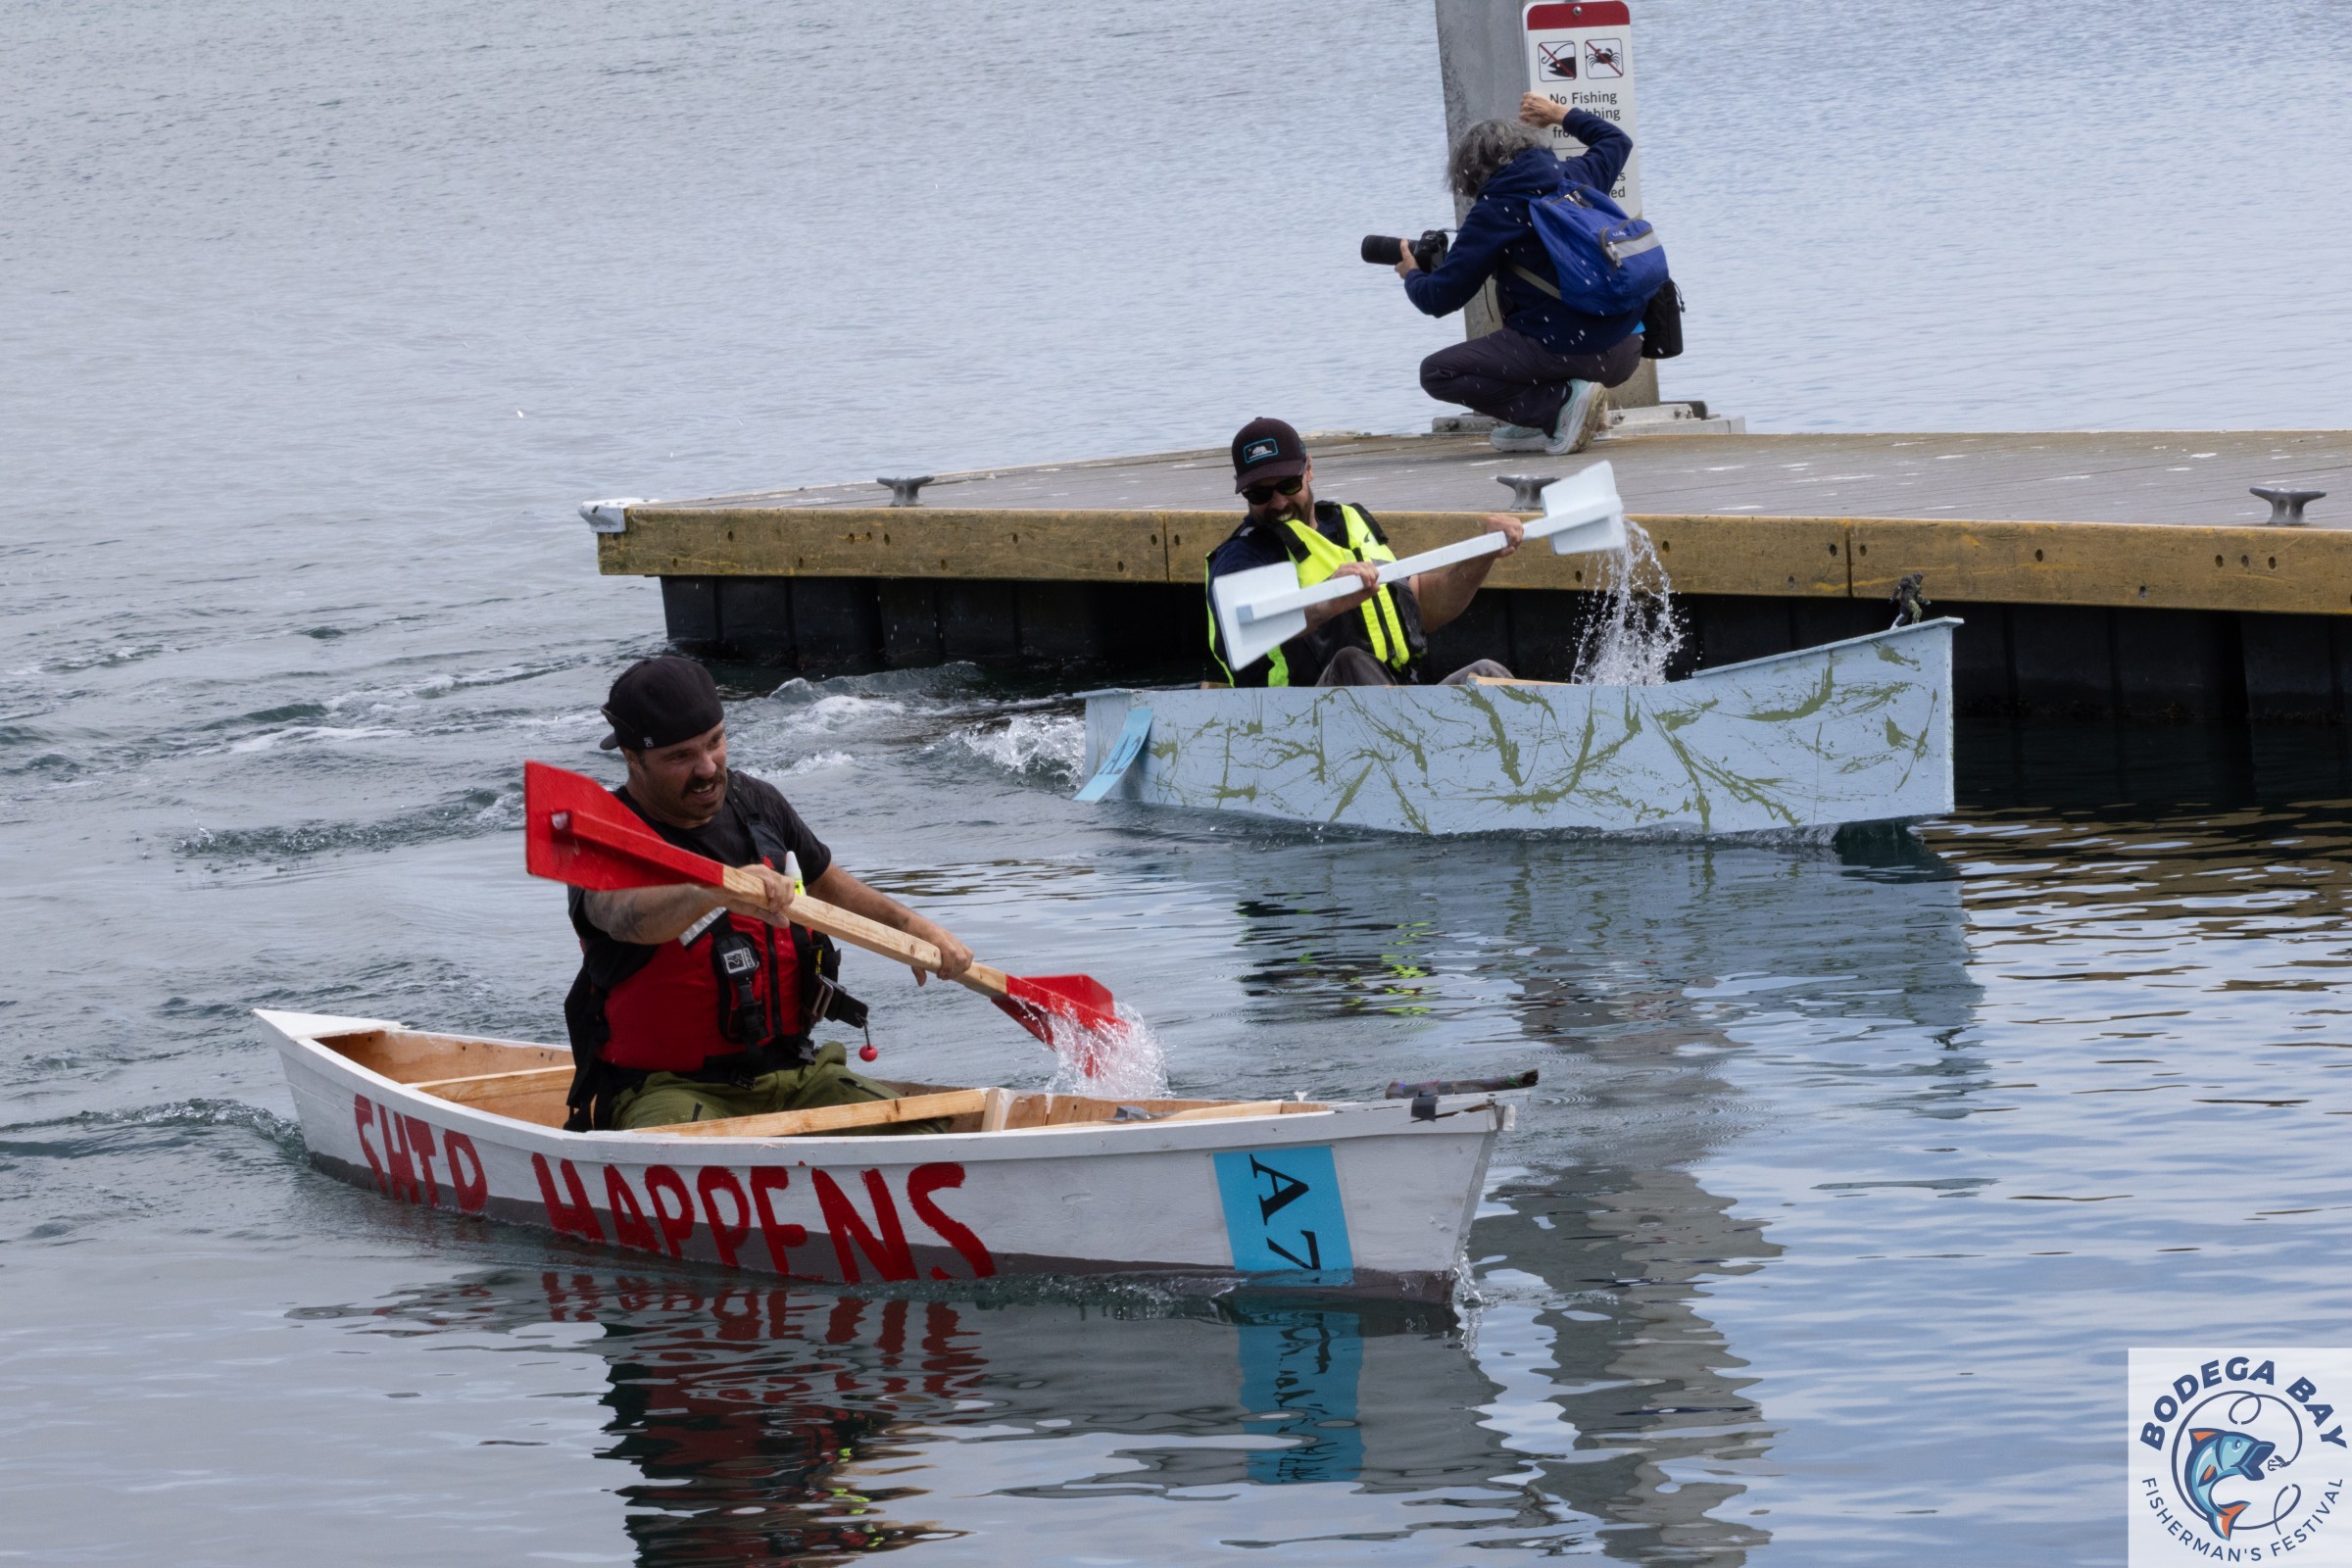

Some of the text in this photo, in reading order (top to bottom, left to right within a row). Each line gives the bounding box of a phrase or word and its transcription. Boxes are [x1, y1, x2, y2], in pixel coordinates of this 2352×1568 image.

[1549, 91, 1617, 105] No Fishing
[531, 1152, 998, 1284] HAPPENS
